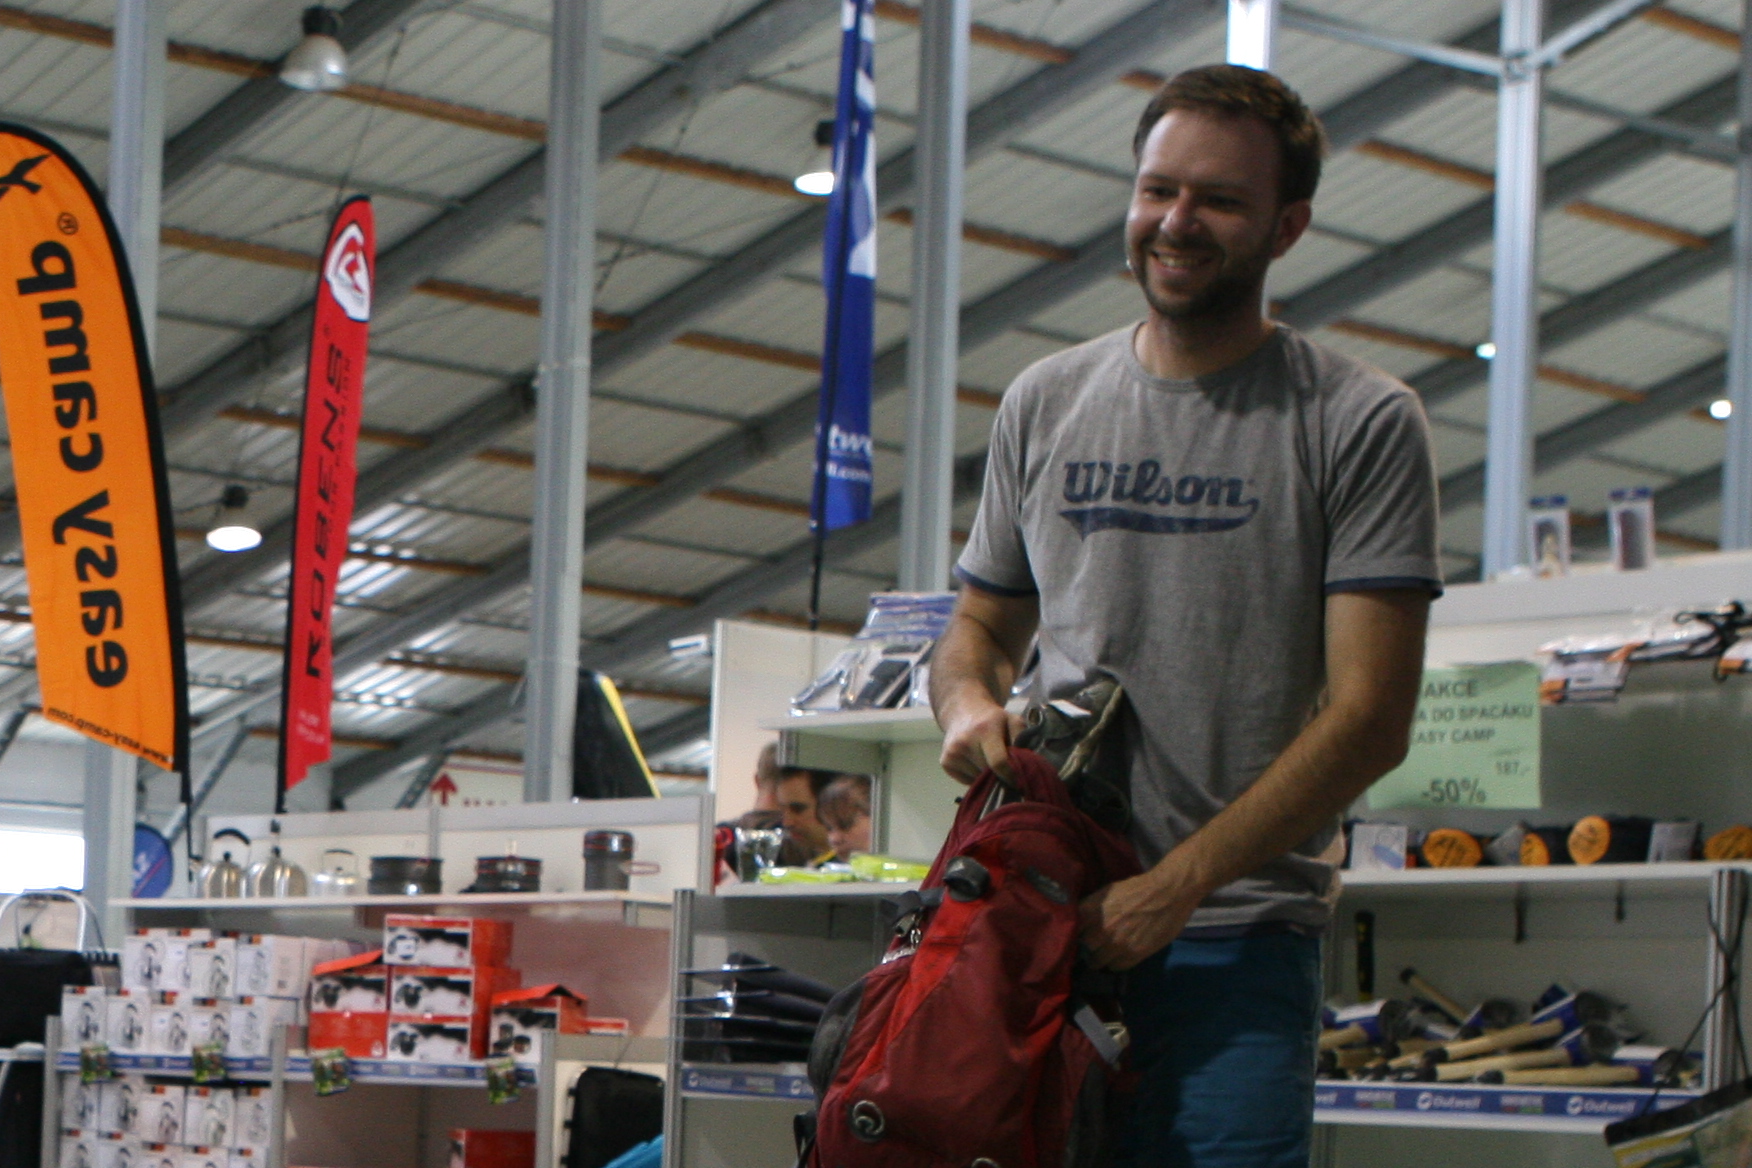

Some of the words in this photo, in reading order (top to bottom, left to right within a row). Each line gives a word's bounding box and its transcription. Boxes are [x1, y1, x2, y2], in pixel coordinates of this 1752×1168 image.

[1062, 458, 1258, 508] Wilson
[304, 342, 344, 679] ROBENS
[1424, 679, 1478, 698] AKCE
[1451, 727, 1496, 744] CAMP
[1422, 777, 1487, 802] -50%
